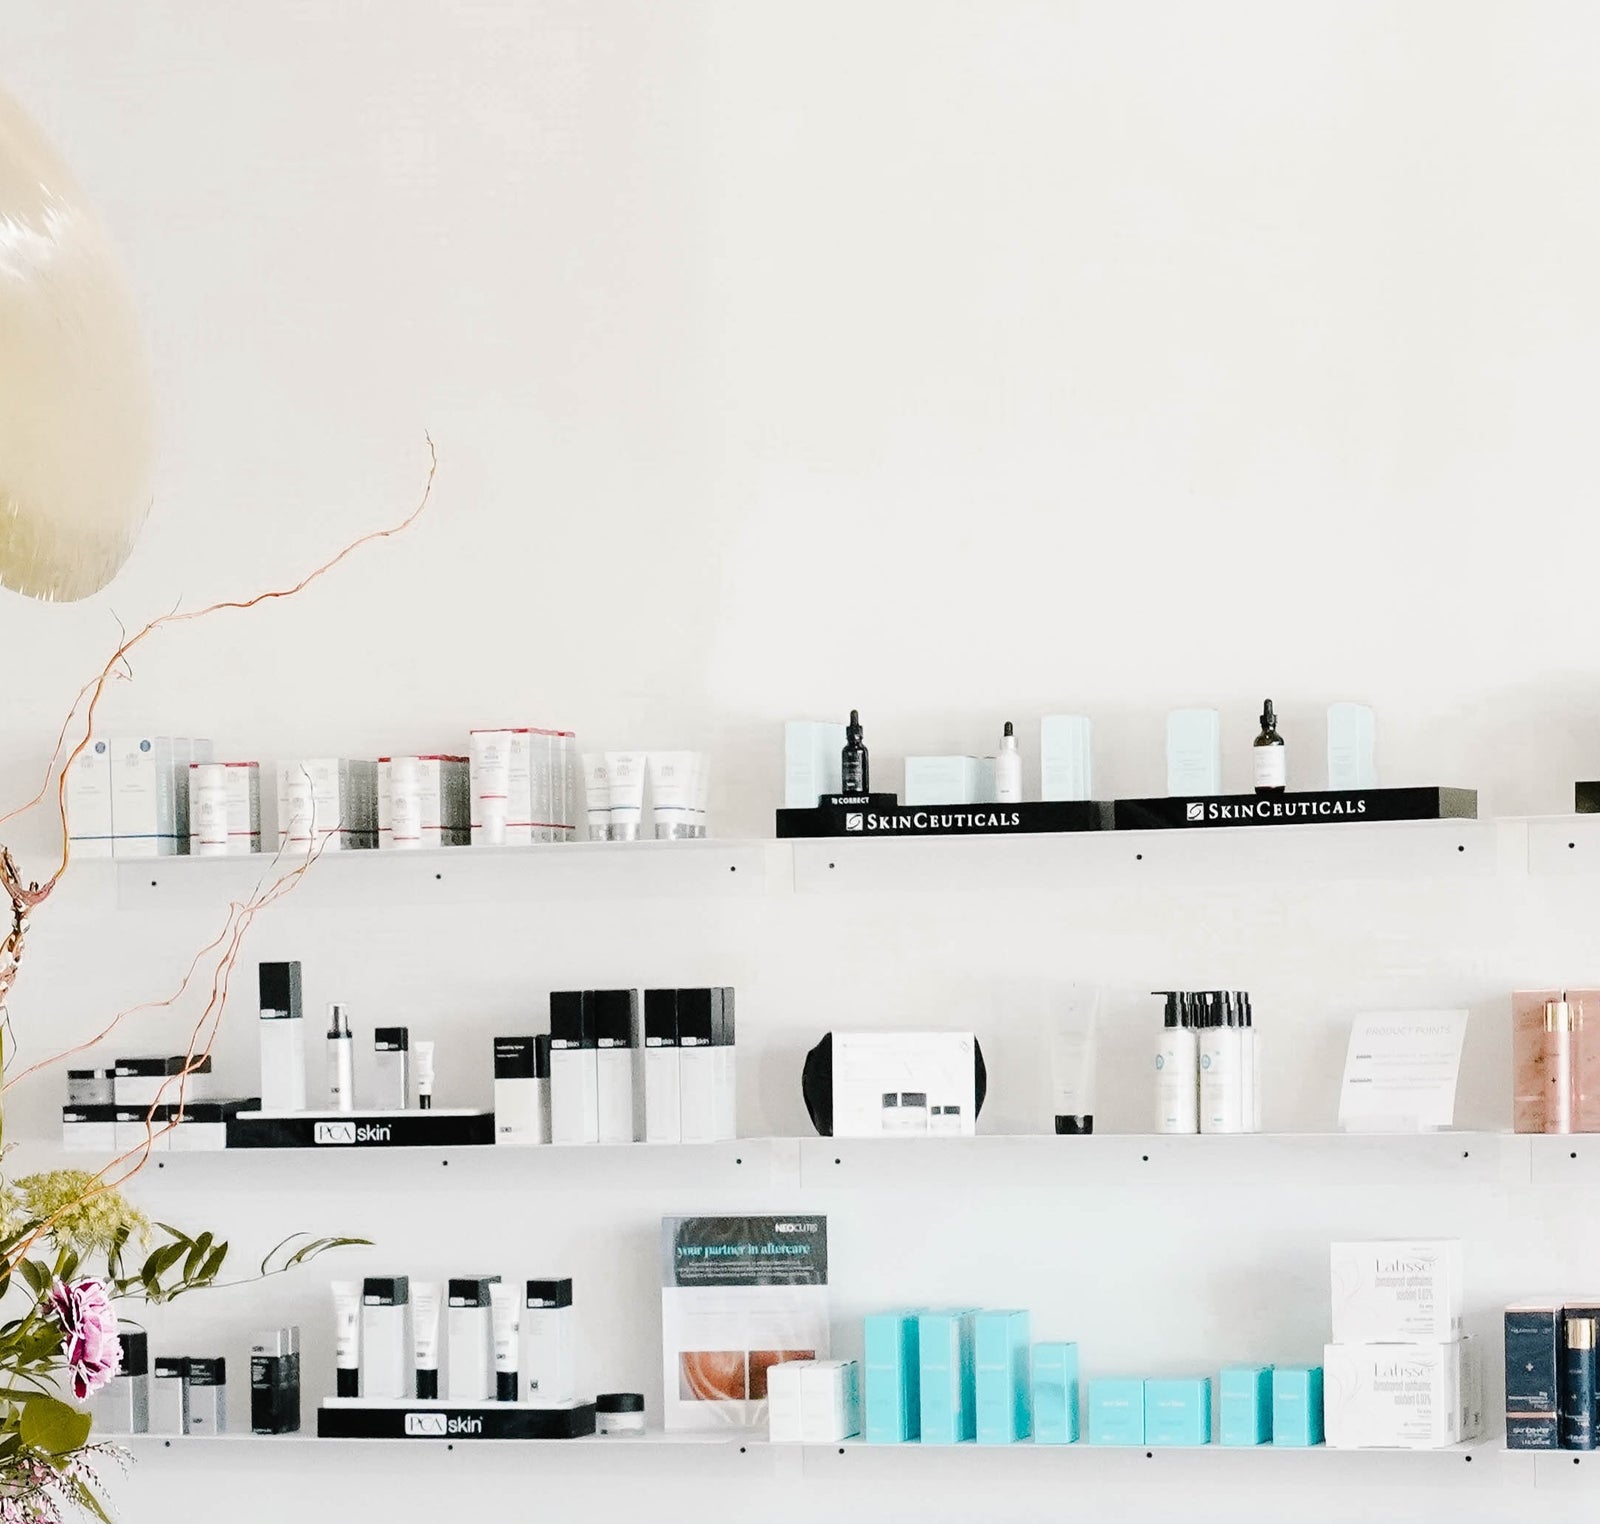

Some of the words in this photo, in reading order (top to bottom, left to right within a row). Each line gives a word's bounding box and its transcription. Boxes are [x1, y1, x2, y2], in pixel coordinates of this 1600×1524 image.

[1365, 1024, 1413, 1036] PRODUCT
[1415, 1023, 1452, 1035] POINTS
[318, 1124, 353, 1141] PCA
[357, 1124, 391, 1141] skin
[677, 1245, 703, 1257] your
[704, 1243, 744, 1257] partner
[748, 1243, 758, 1255] in
[761, 1242, 810, 1255] aftercare
[409, 1416, 444, 1433] PCA
[448, 1416, 482, 1433] skin
